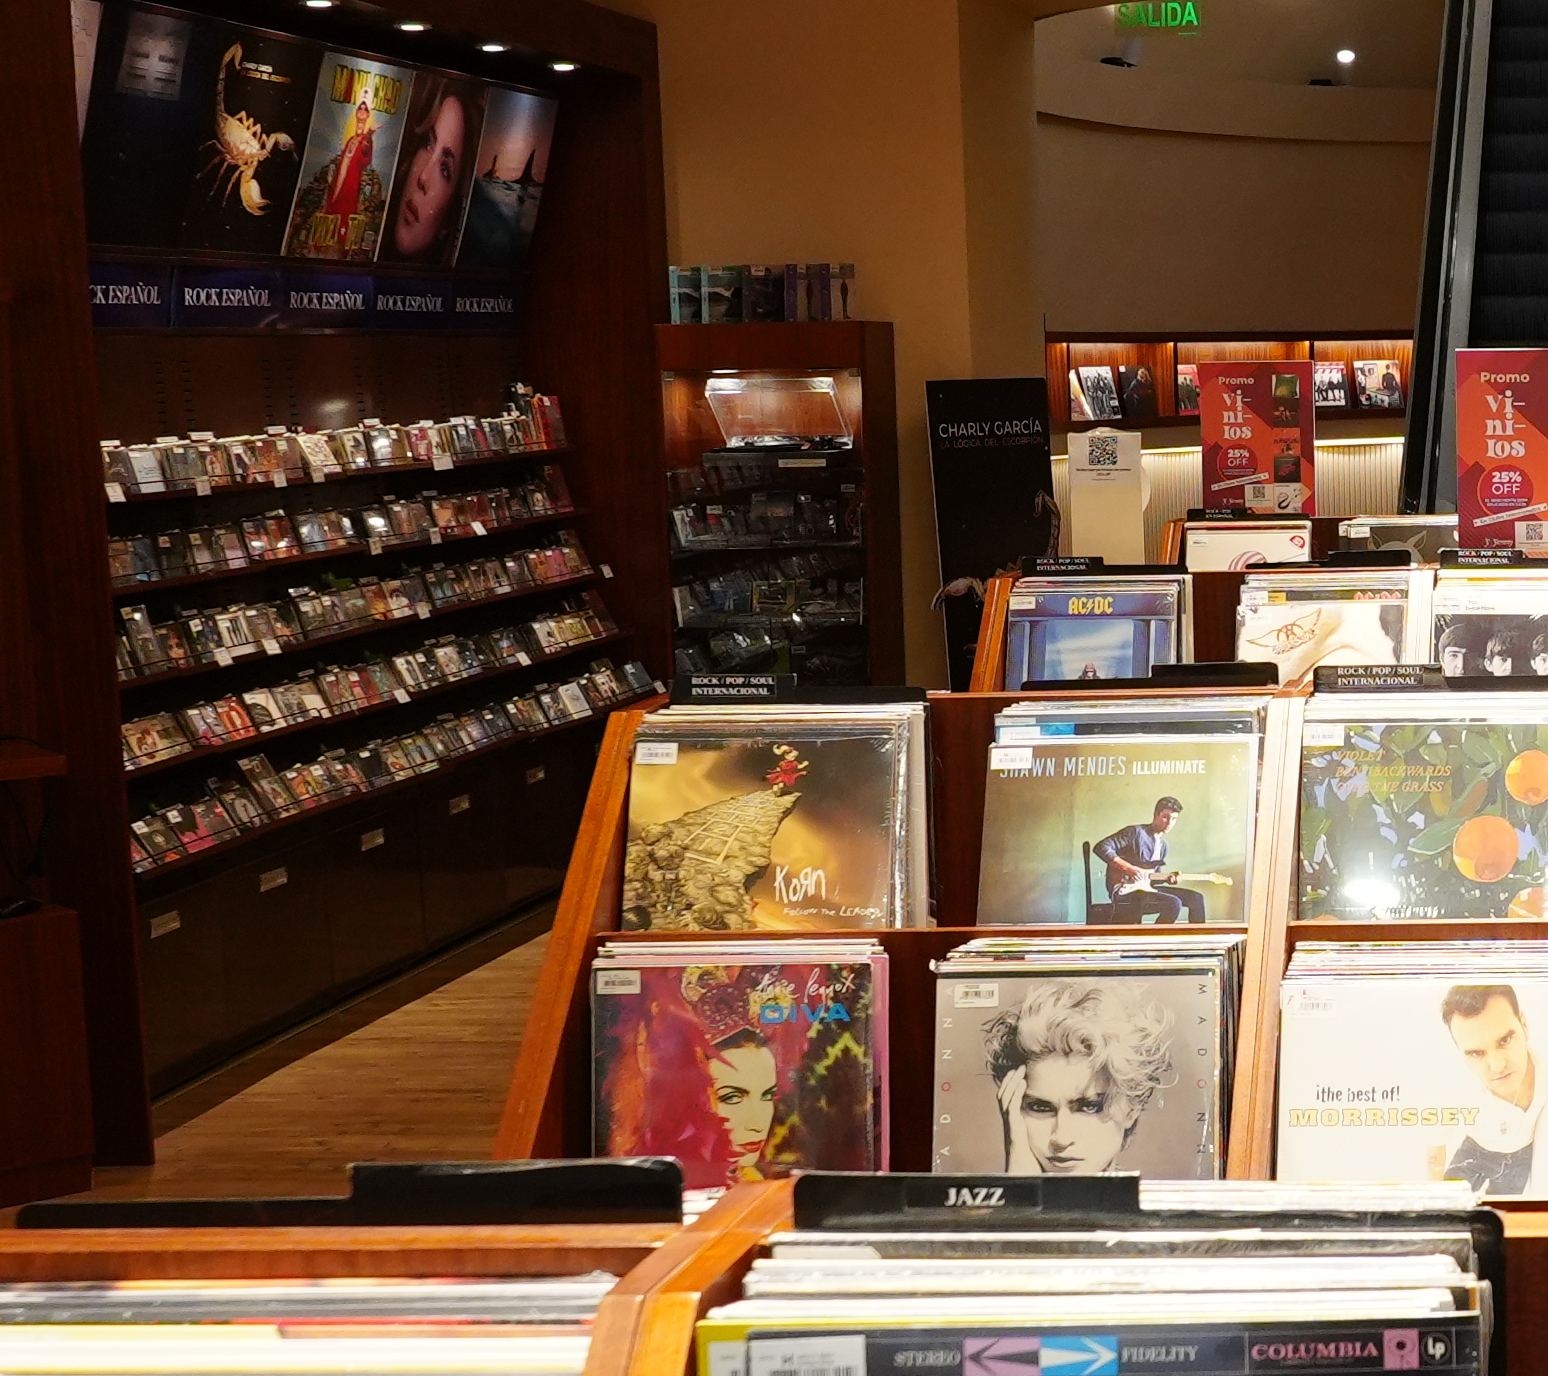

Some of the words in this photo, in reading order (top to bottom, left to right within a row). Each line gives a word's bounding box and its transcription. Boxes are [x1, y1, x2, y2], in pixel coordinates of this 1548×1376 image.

[1115, 0, 1200, 31] SALIDA
[108, 279, 161, 306] ESPAÑOL
[184, 287, 220, 306] ROCK
[221, 285, 271, 309] ESPAÑOL
[289, 292, 319, 311] ROCK
[320, 288, 365, 312] ESPAÑOL
[376, 294, 403, 312] ROCK
[404, 293, 444, 314] ESPAÑOL
[456, 296, 479, 314] ROCK
[479, 293, 514, 314] ESPAÑOL
[1218, 376, 1254, 386] Promo
[1480, 372, 1530, 383] Promo
[938, 421, 991, 438] CHARLY
[995, 417, 1043, 435] GARCÍA
[953, 437, 983, 450] LÓGICA
[985, 437, 1000, 447] DEL
[1002, 434, 1044, 447] ESCORPIÓN
[1227, 449, 1249, 458] 25%
[1227, 458, 1249, 466] OFF
[1491, 472, 1522, 483] 25%
[1491, 484, 1521, 495] OFF
[1068, 596, 1114, 616] AC/DC
[692, 677, 720, 685] ROCK
[725, 677, 744, 685] POP
[750, 677, 775, 685] SOUL
[1337, 676, 1419, 686] INTERNACIONAL
[1338, 667, 1364, 677] ROCK
[1372, 667, 1389, 677] POP
[1396, 667, 1423, 677] SOUL
[692, 687, 770, 696] INTERNACIONAL
[1337, 750, 1386, 762] VIOLET
[1062, 756, 1126, 777] MENDES
[1131, 758, 1206, 776] ILLUMINATE
[1374, 765, 1452, 777] BACKWARDS
[1402, 781, 1445, 792] GRASS
[759, 1002, 852, 1024] DIVA
[1346, 1084, 1377, 1103] best
[1288, 1108, 1480, 1128] MORRISSEY
[944, 1186, 1006, 1207] JAZZ
[894, 1349, 962, 1367] STEREO
[1121, 1345, 1199, 1363] FIDELITY
[1252, 1342, 1379, 1361] COLUMBIA
